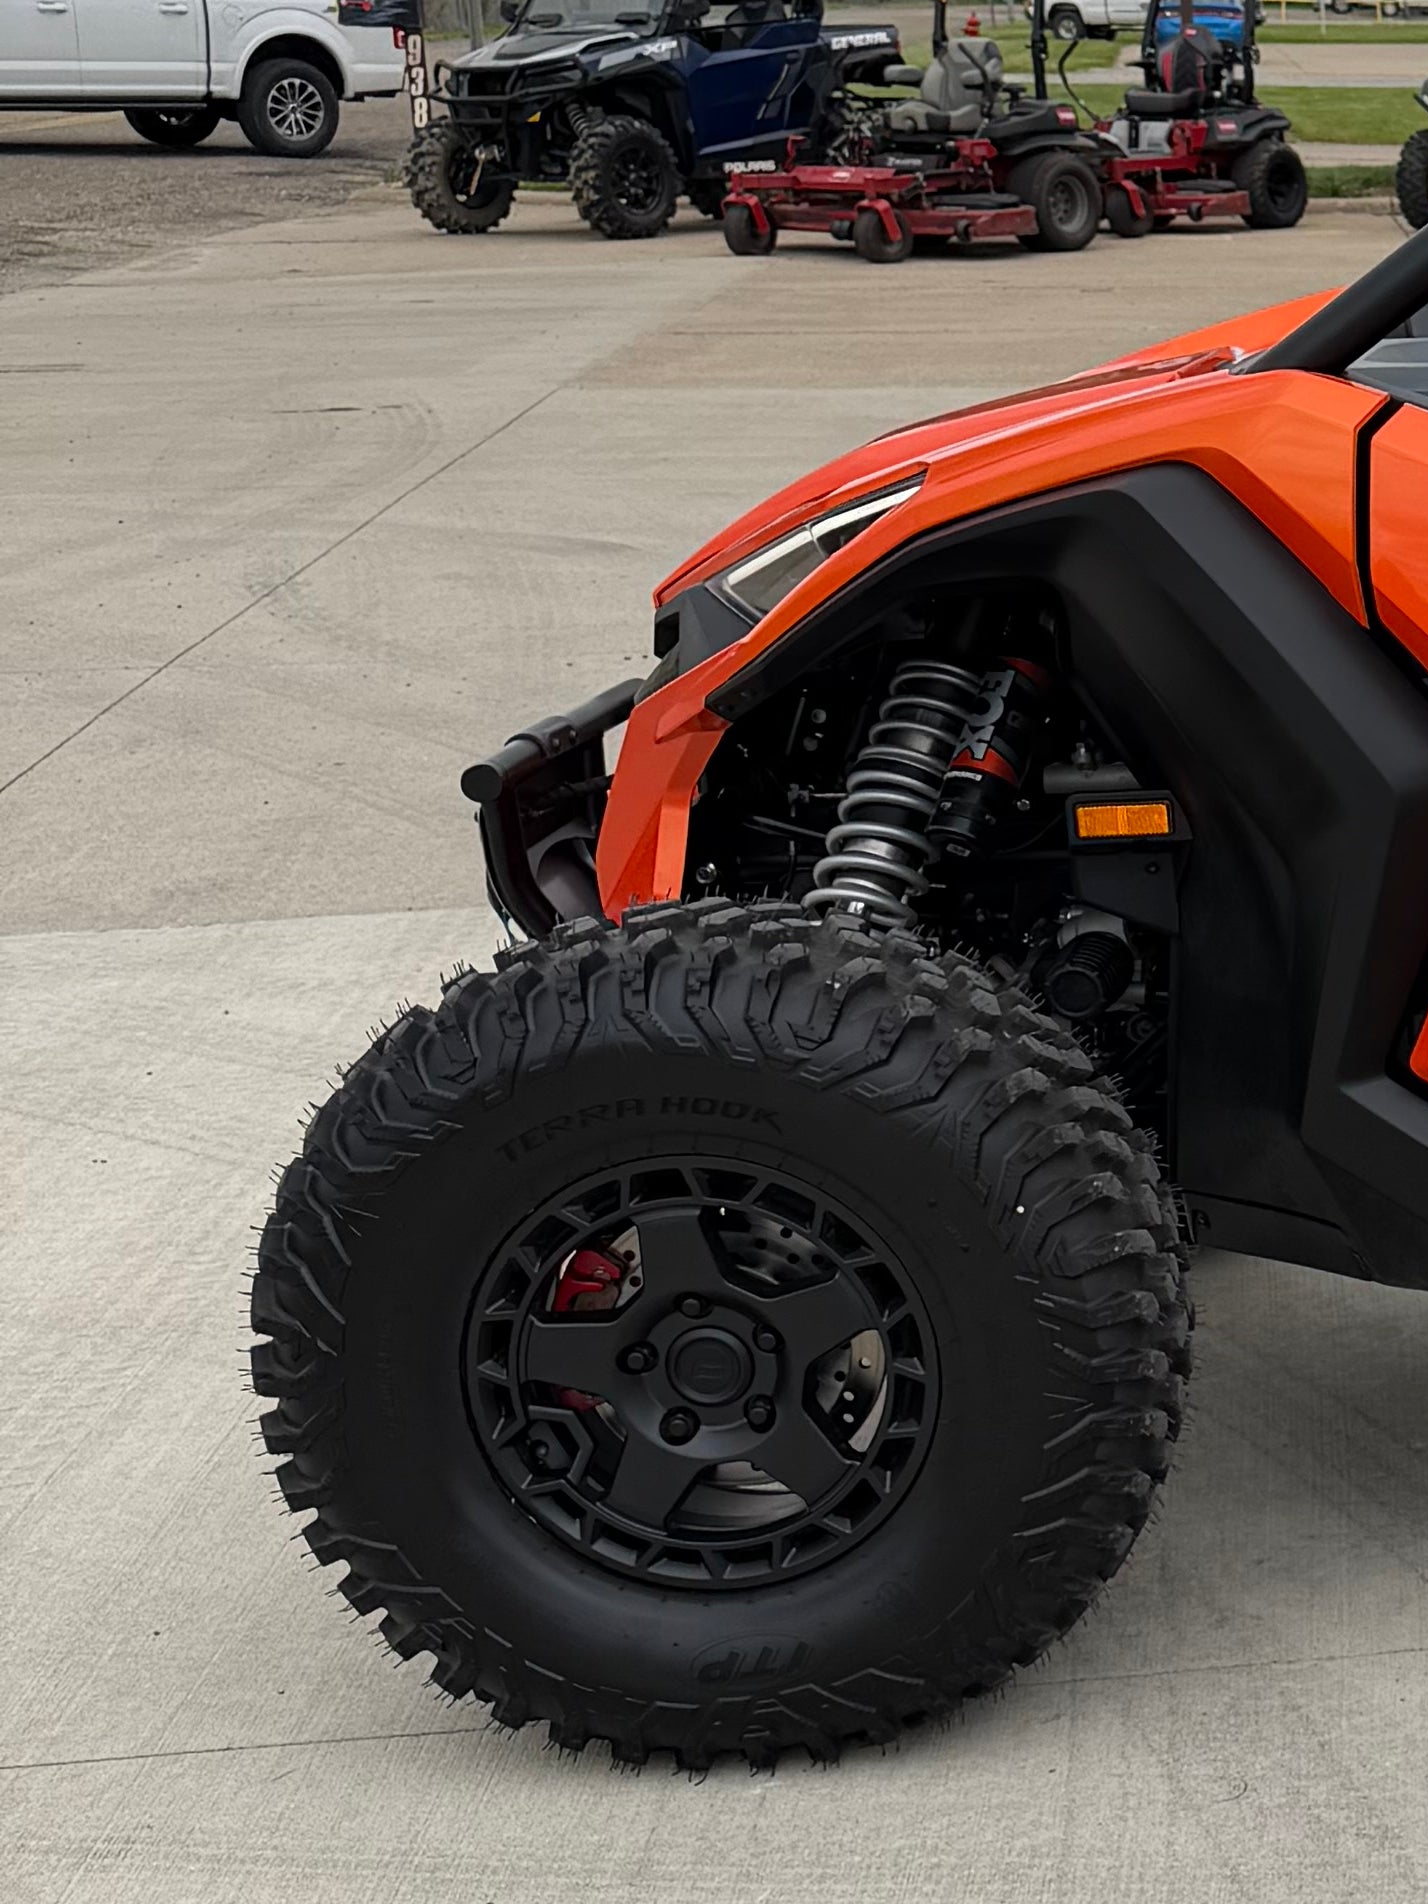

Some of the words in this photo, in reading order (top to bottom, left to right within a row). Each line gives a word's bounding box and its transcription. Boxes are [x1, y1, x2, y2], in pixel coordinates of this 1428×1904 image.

[407, 34, 428, 128] 938
[723, 160, 776, 173] POLARIS
[495, 1097, 648, 1163] TERRA
[659, 1095, 785, 1136] HOOK
